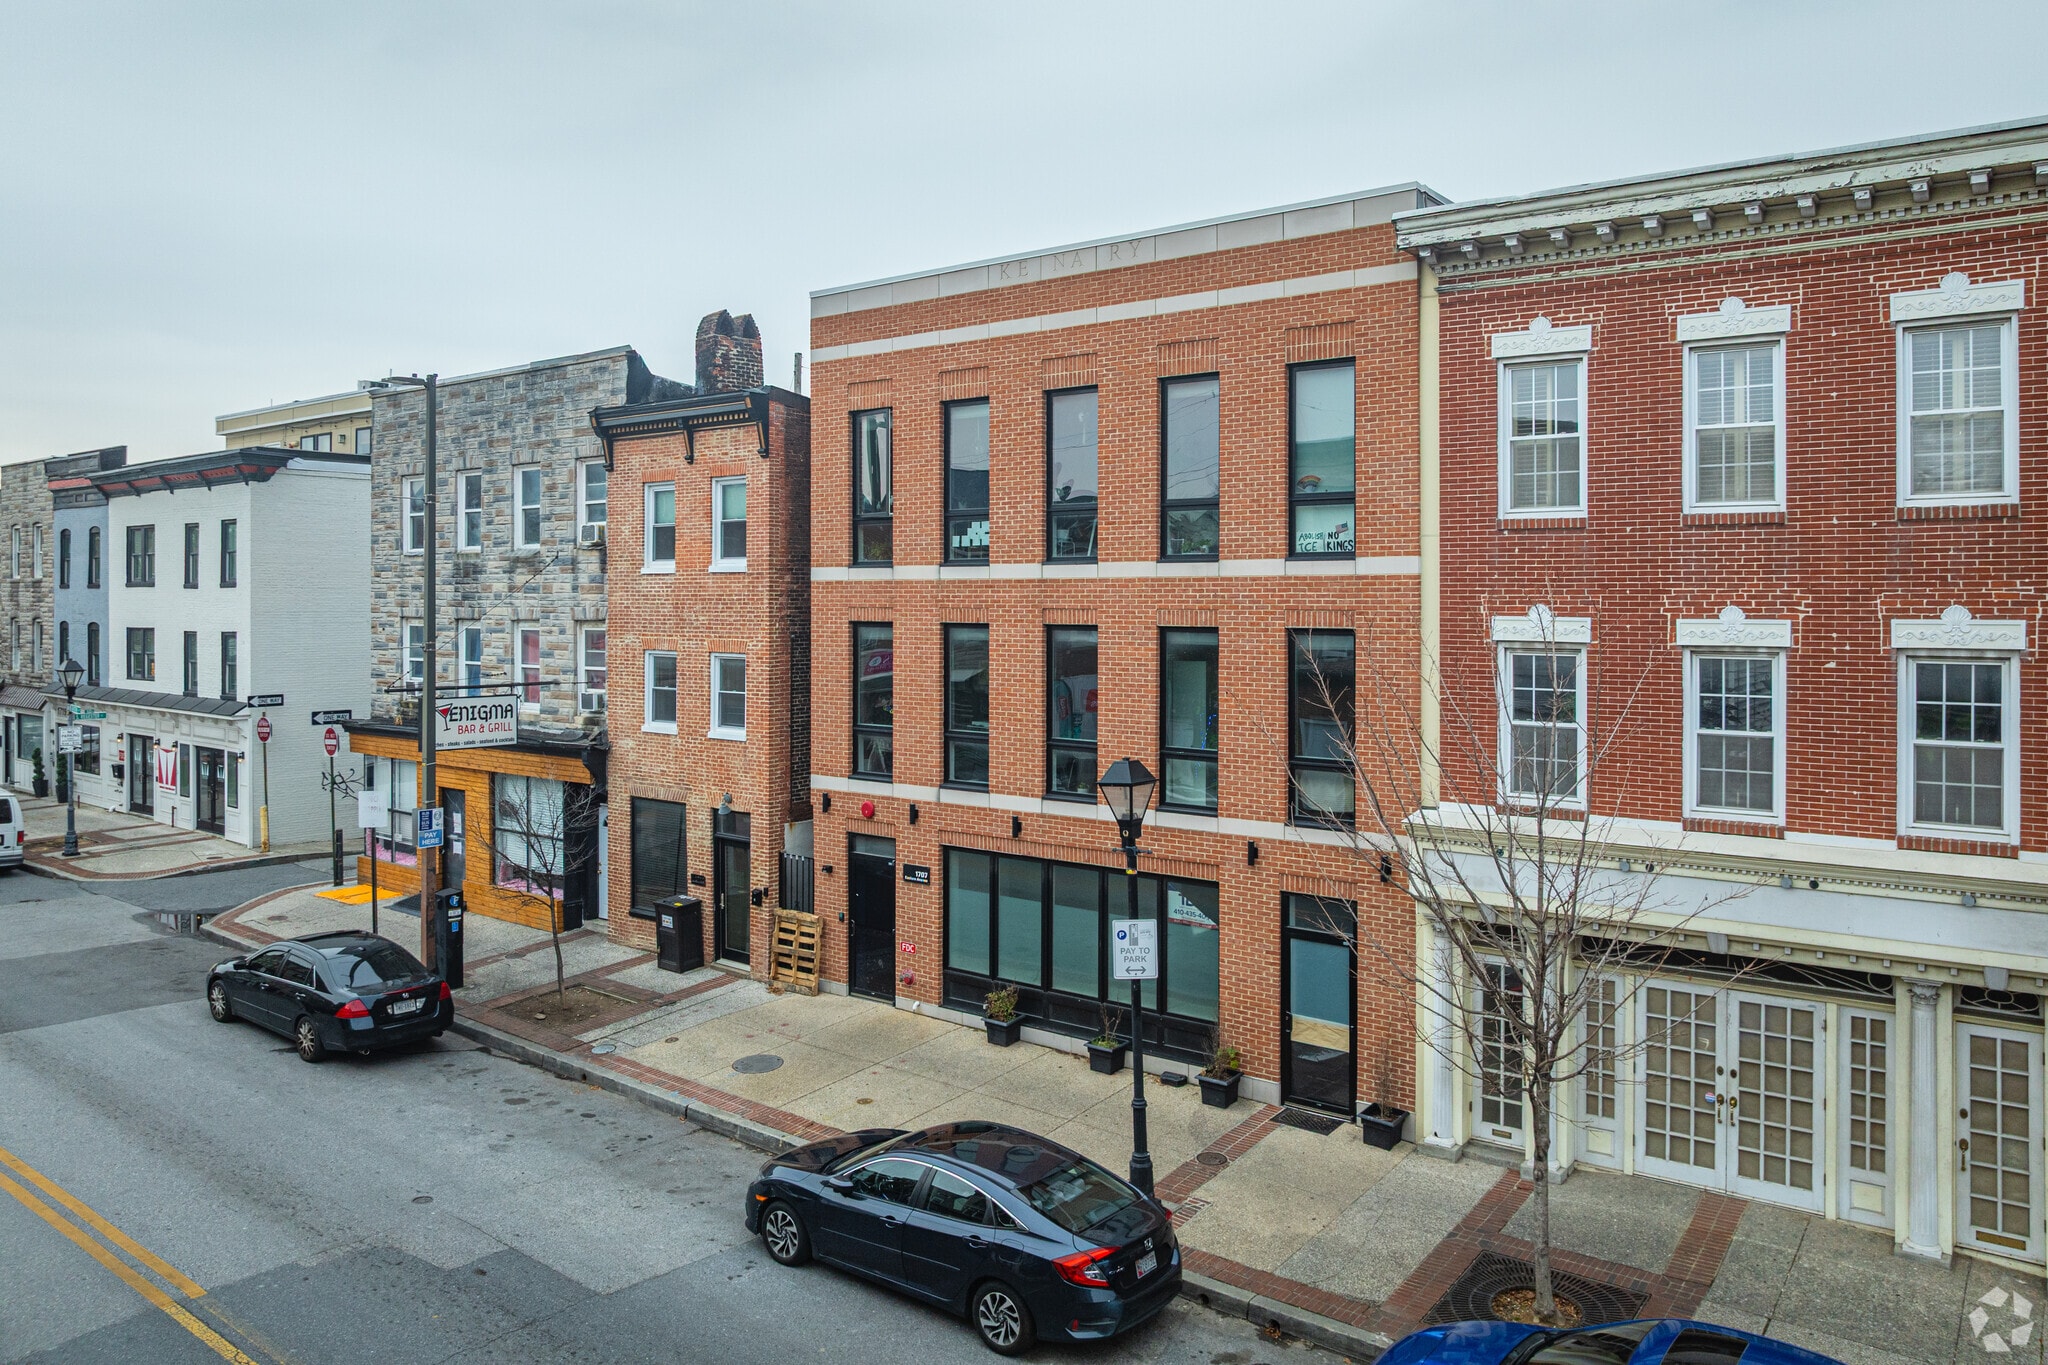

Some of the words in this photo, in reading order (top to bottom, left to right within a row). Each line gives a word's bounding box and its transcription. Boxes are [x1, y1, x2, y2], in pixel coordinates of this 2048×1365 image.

[1298, 531, 1324, 541] ABOLISH
[1327, 531, 1340, 540] NO
[1298, 541, 1318, 553] ICE
[1326, 539, 1354, 552] KINGS
[336, 712, 348, 720] WAY
[448, 703, 514, 723] ENIGMA
[457, 724, 476, 735] BAR
[479, 723, 485, 733] &
[488, 722, 513, 733] GRILL
[424, 831, 437, 839] PAY
[421, 837, 440, 846] HERE
[915, 870, 928, 879] 1707
[1173, 908, 1209, 921] 410-435-40
[901, 942, 915, 953] FDC
[1123, 955, 1147, 963] PARK
